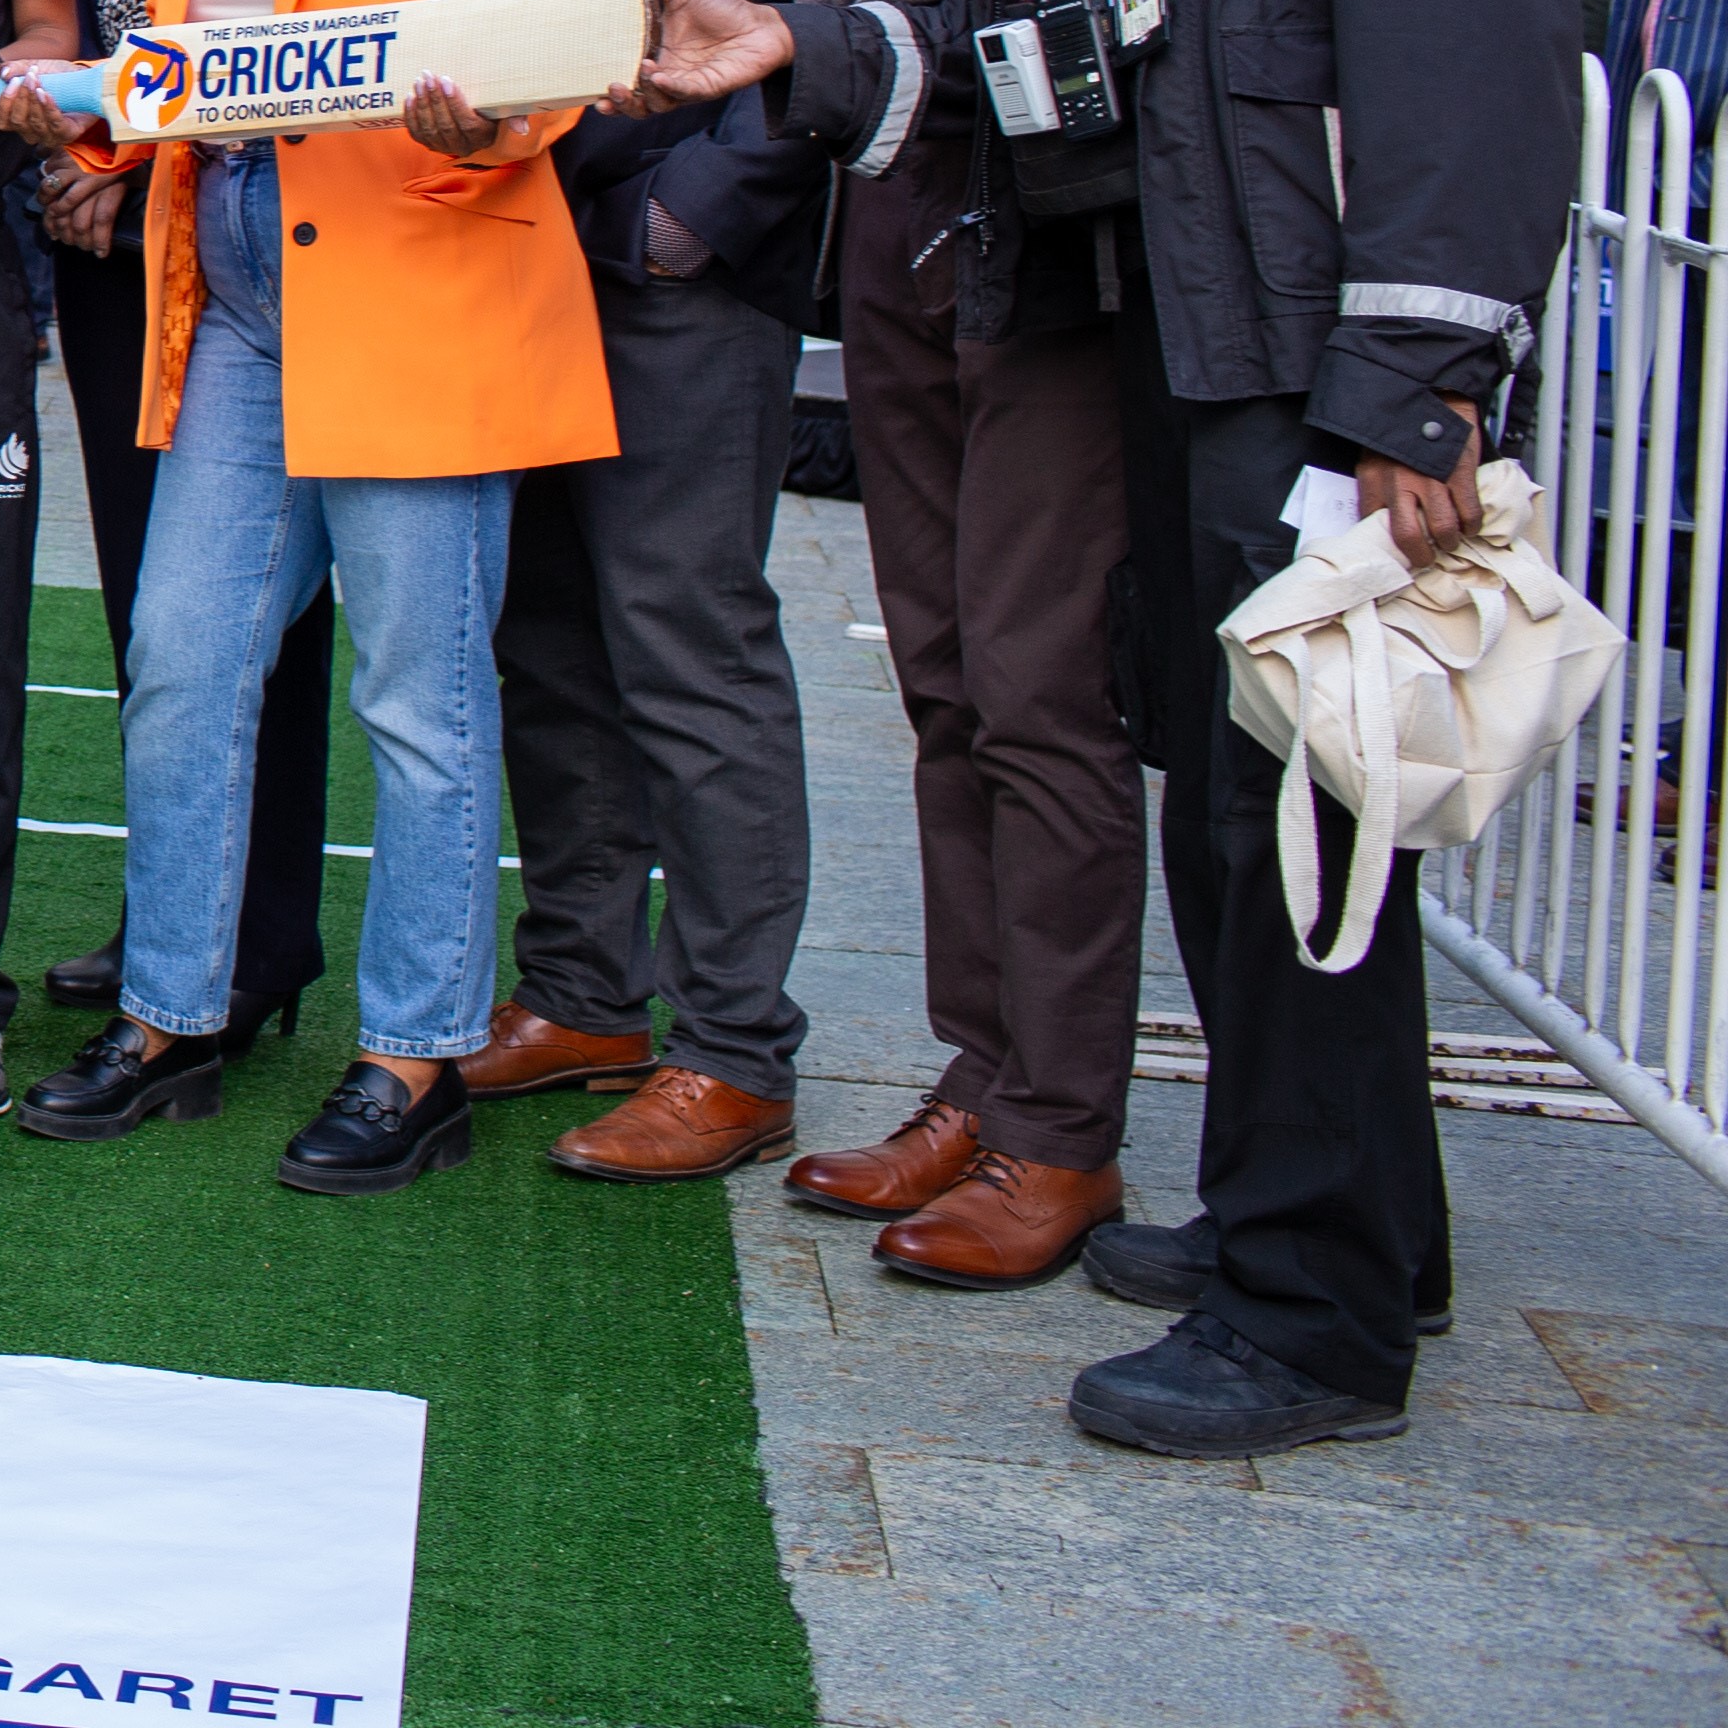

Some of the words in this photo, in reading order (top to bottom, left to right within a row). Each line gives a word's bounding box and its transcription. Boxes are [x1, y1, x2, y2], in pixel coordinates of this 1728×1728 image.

[203, 28, 231, 42] THE
[235, 20, 309, 39] PRINCESS
[313, 10, 400, 32] MARGARET
[199, 32, 397, 99] CRICKET
[196, 107, 219, 123] TO
[224, 99, 313, 120] CONQUER
[318, 91, 394, 114] CANCER
